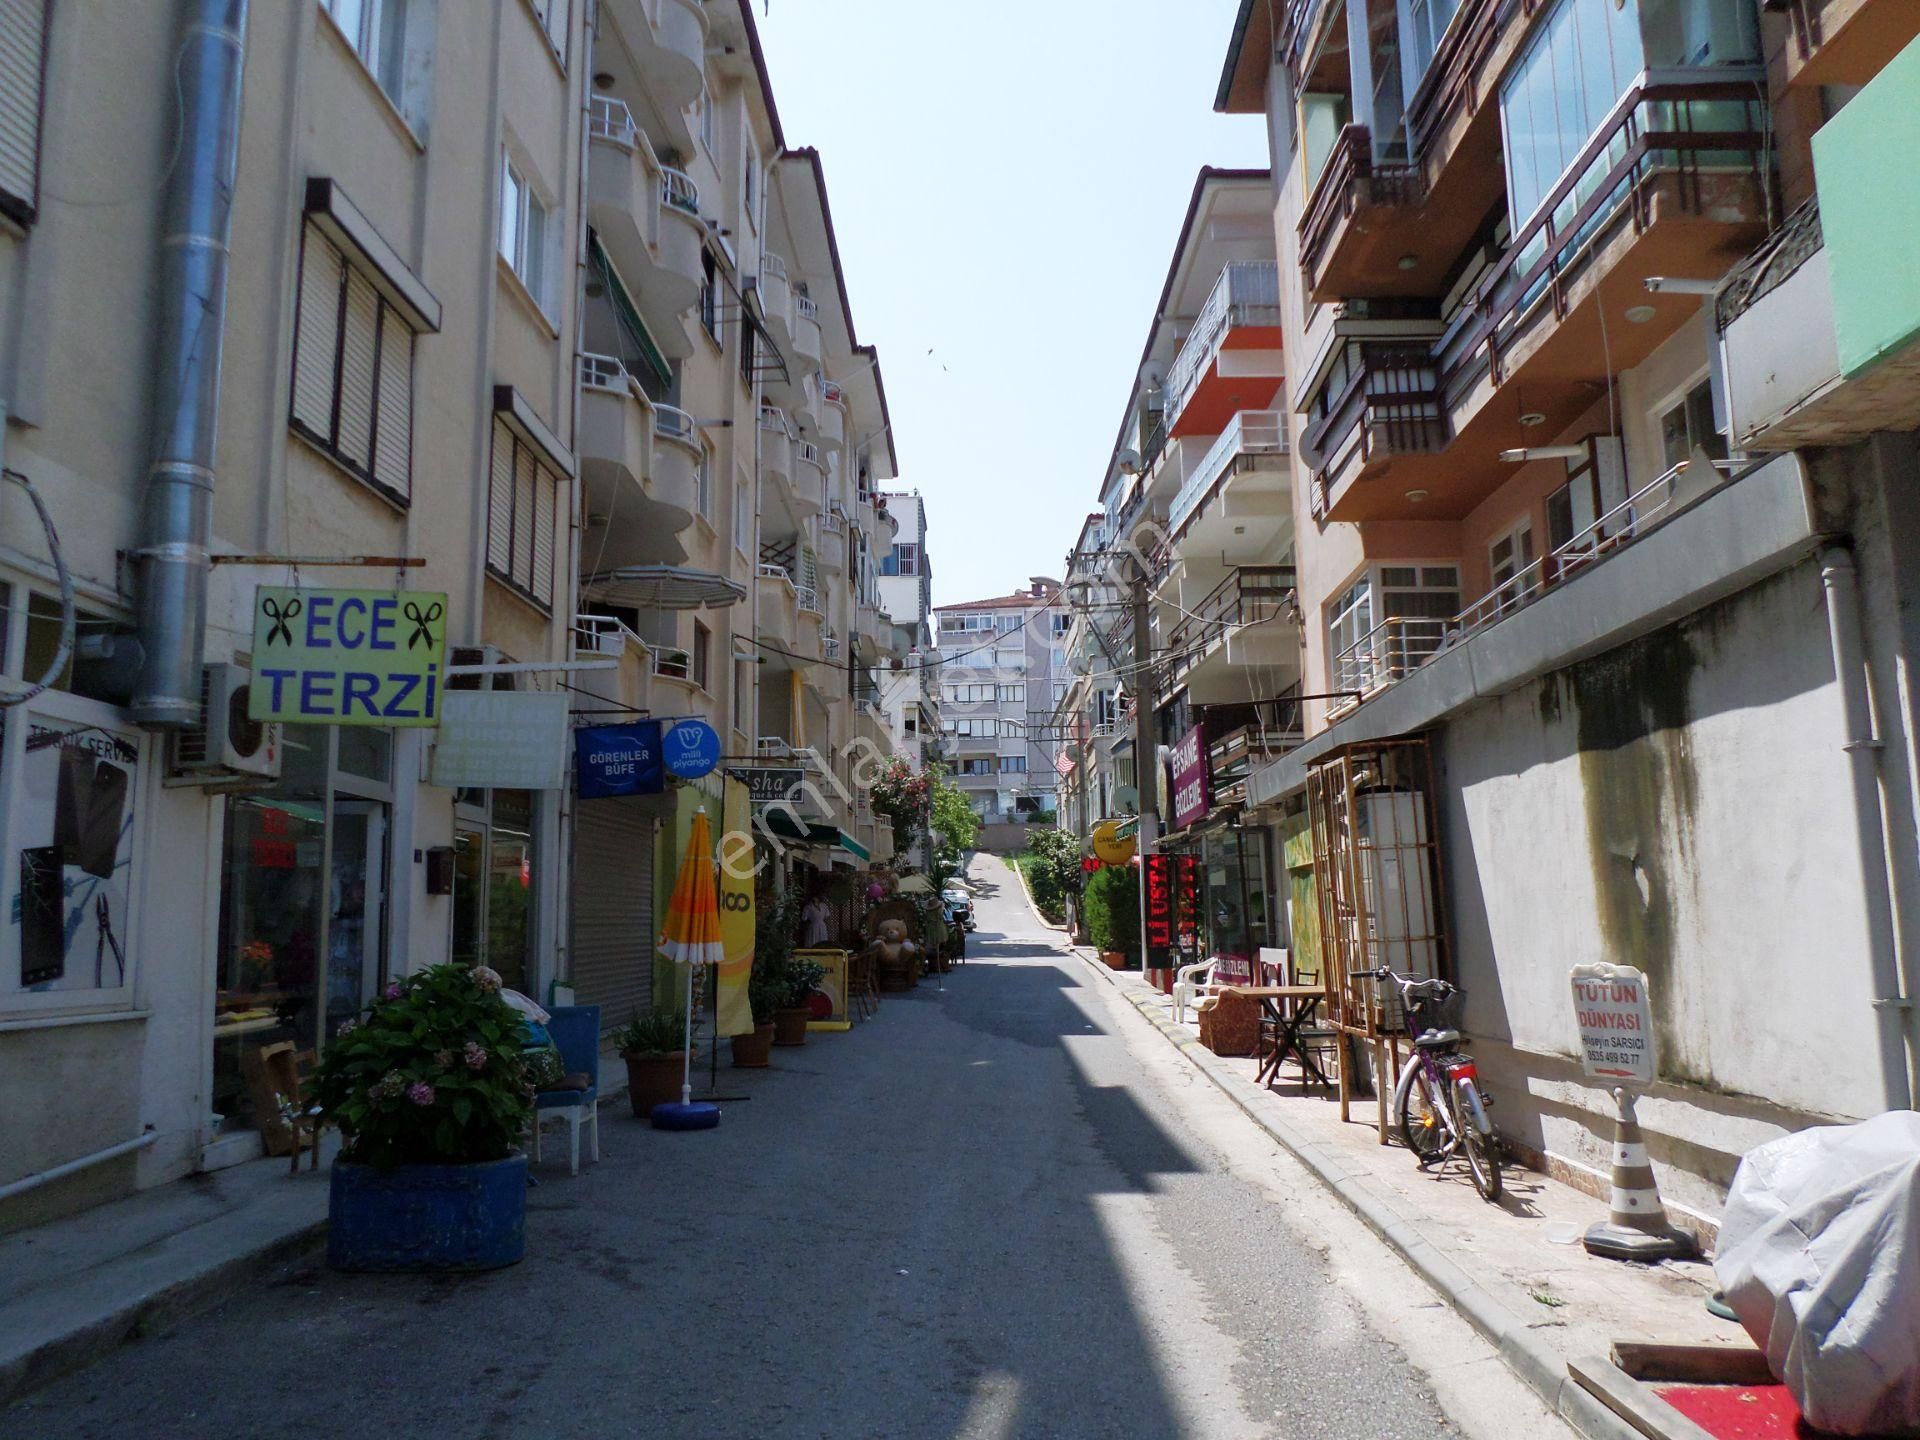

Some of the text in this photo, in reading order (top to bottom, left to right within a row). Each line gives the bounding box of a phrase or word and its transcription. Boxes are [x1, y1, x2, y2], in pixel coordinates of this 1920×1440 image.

[306, 597, 398, 650] ECE
[260, 663, 437, 718] TERZİ
[590, 750, 649, 764] GÖRENLER
[673, 758, 711, 769] piyango
[681, 751, 701, 759] milli
[1173, 736, 1198, 780] EFSANE
[605, 763, 635, 776] BÜFE
[1175, 778, 1202, 818] GÖZLEME
[1575, 981, 1638, 1003] TÜTÜN
[1579, 1008, 1640, 1031] DÜNYASI
[1582, 1034, 1609, 1049] Hüseyin
